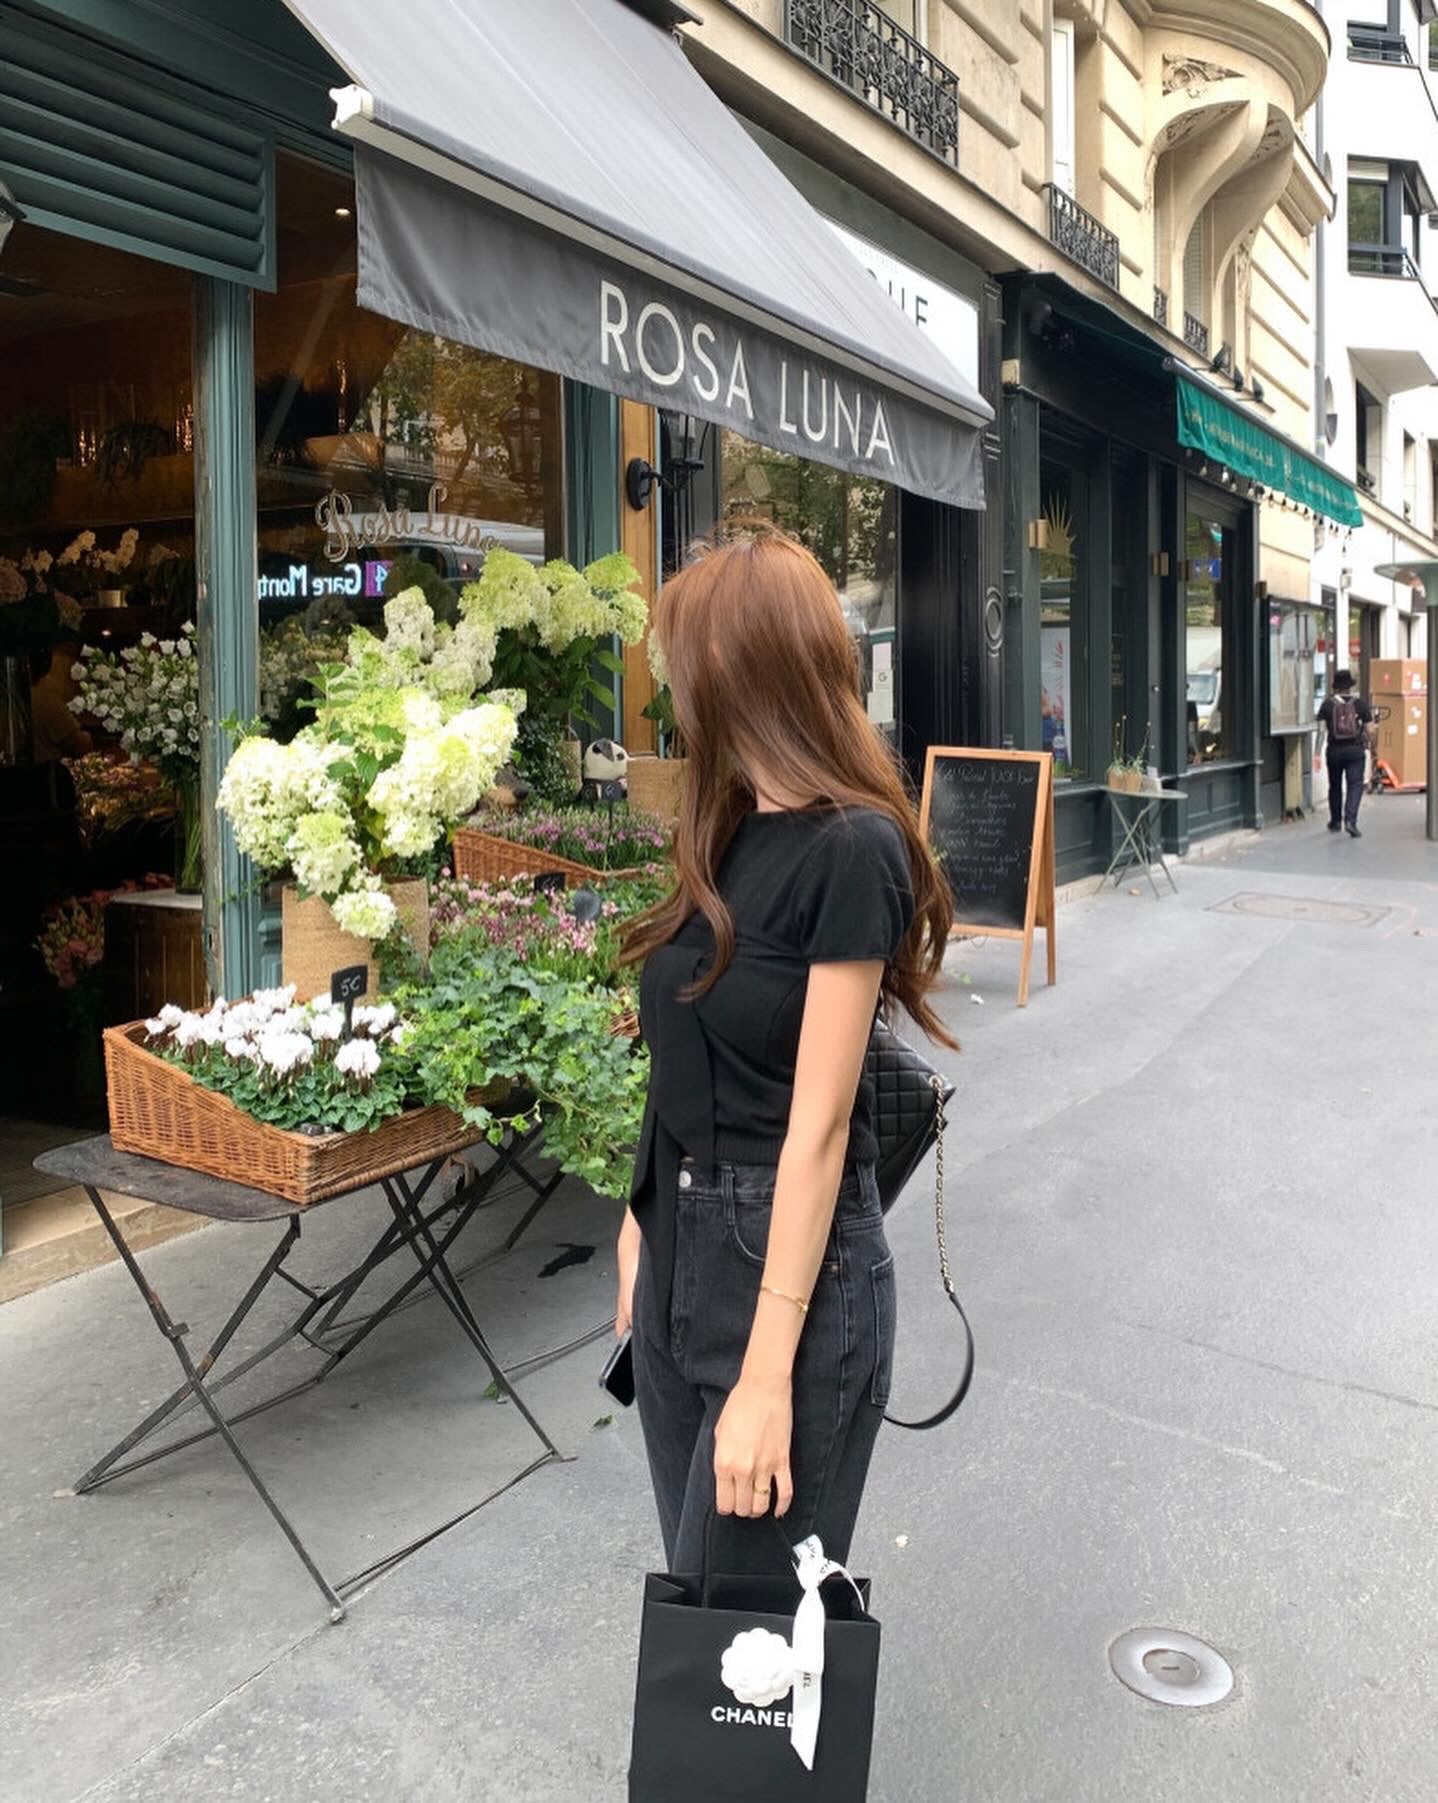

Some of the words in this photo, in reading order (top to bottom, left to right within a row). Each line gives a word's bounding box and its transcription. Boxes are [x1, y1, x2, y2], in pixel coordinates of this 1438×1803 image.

[600, 279, 755, 420] ROSA
[778, 360, 896, 466] LUNA
[315, 488, 413, 562] Rosa
